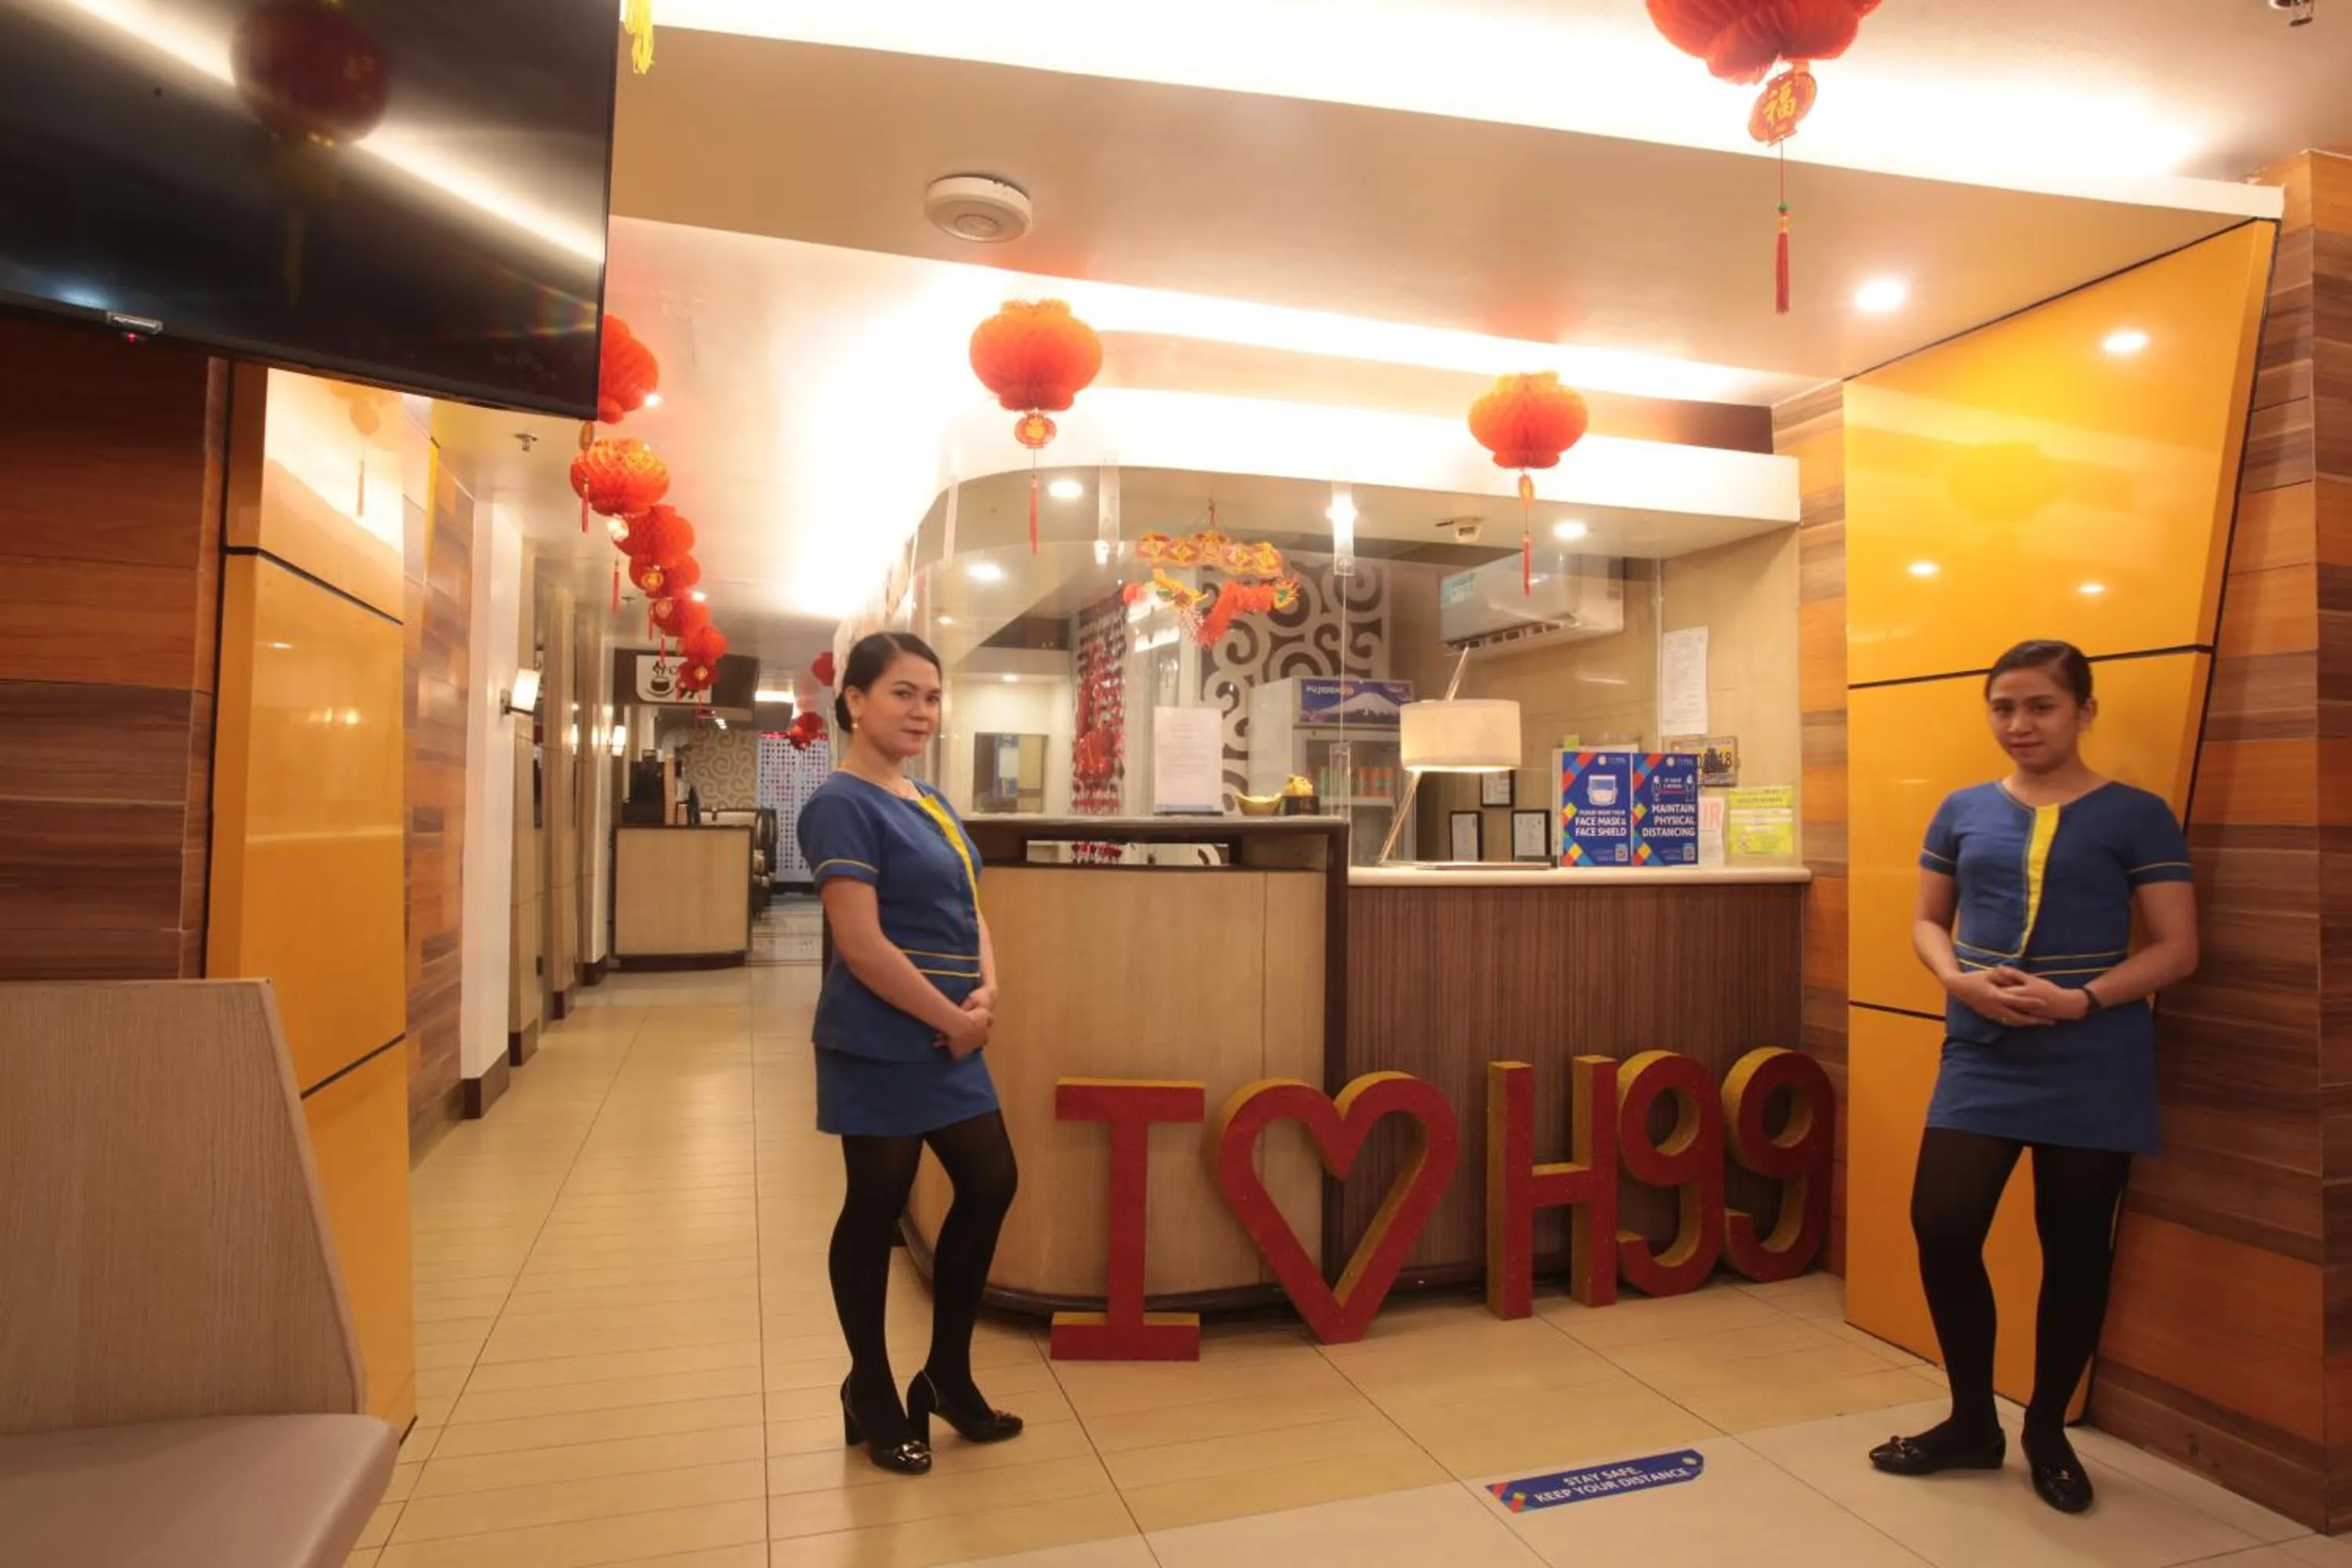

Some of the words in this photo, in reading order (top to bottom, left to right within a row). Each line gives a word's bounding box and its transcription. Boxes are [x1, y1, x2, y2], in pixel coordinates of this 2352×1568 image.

[1765, 81, 1797, 126] 福
[1652, 804, 1695, 813] MAINTAIN
[1575, 817, 1596, 826] FACE
[1598, 817, 1621, 826] MASK
[1653, 815, 1695, 826] PHYSICAL
[1575, 827, 1596, 837] FACE
[1598, 827, 1627, 837] SHIELD
[1642, 827, 1696, 837] DISTANCING
[1050, 1077, 1205, 1361] I
[1486, 1047, 1836, 1319] H99
[1563, 1472, 1600, 1486] STAY
[1534, 1487, 1572, 1503] KEEP
[1573, 1480, 1620, 1495] YOUR
